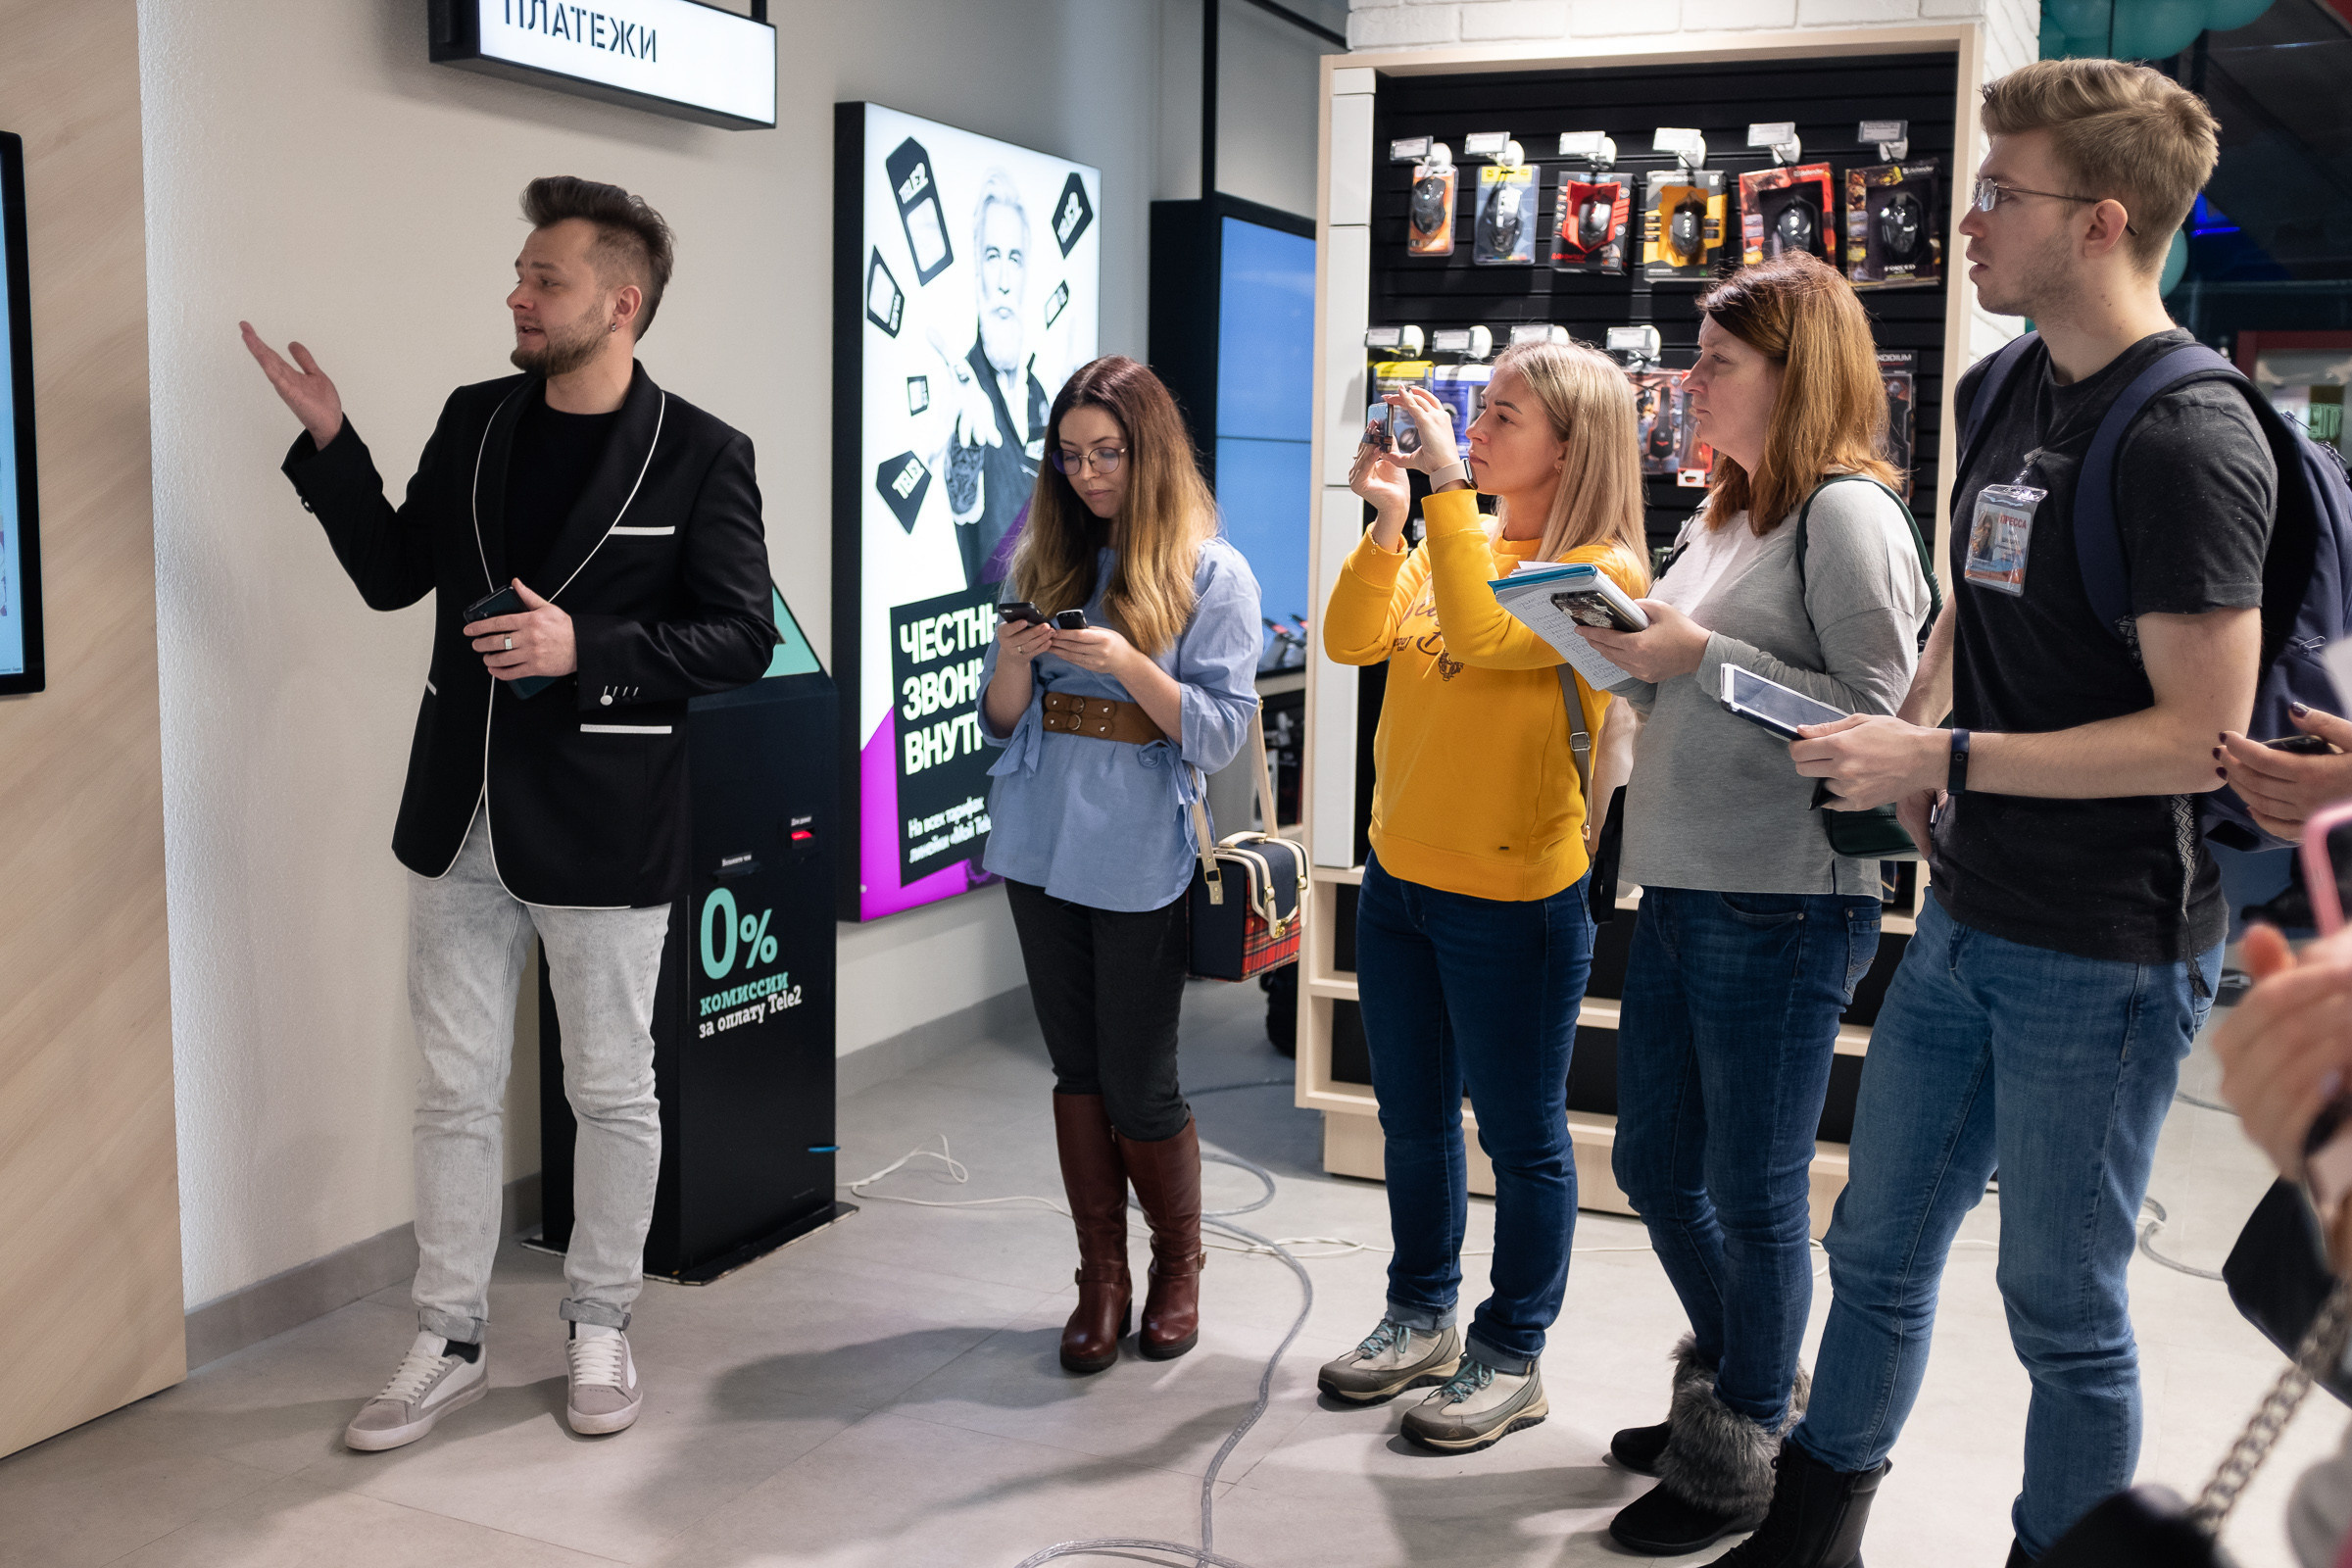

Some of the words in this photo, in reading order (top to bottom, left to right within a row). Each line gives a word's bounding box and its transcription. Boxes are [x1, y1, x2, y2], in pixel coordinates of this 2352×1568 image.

[504, 0, 658, 63] ПЛАТЕЖИ
[1999, 514, 2028, 529] ПРЕССА
[700, 887, 778, 980] 0%
[699, 971, 789, 1017] комиссии
[699, 1019, 714, 1039] за
[716, 1002, 765, 1033] оплату
[767, 984, 802, 1015] Tele2
